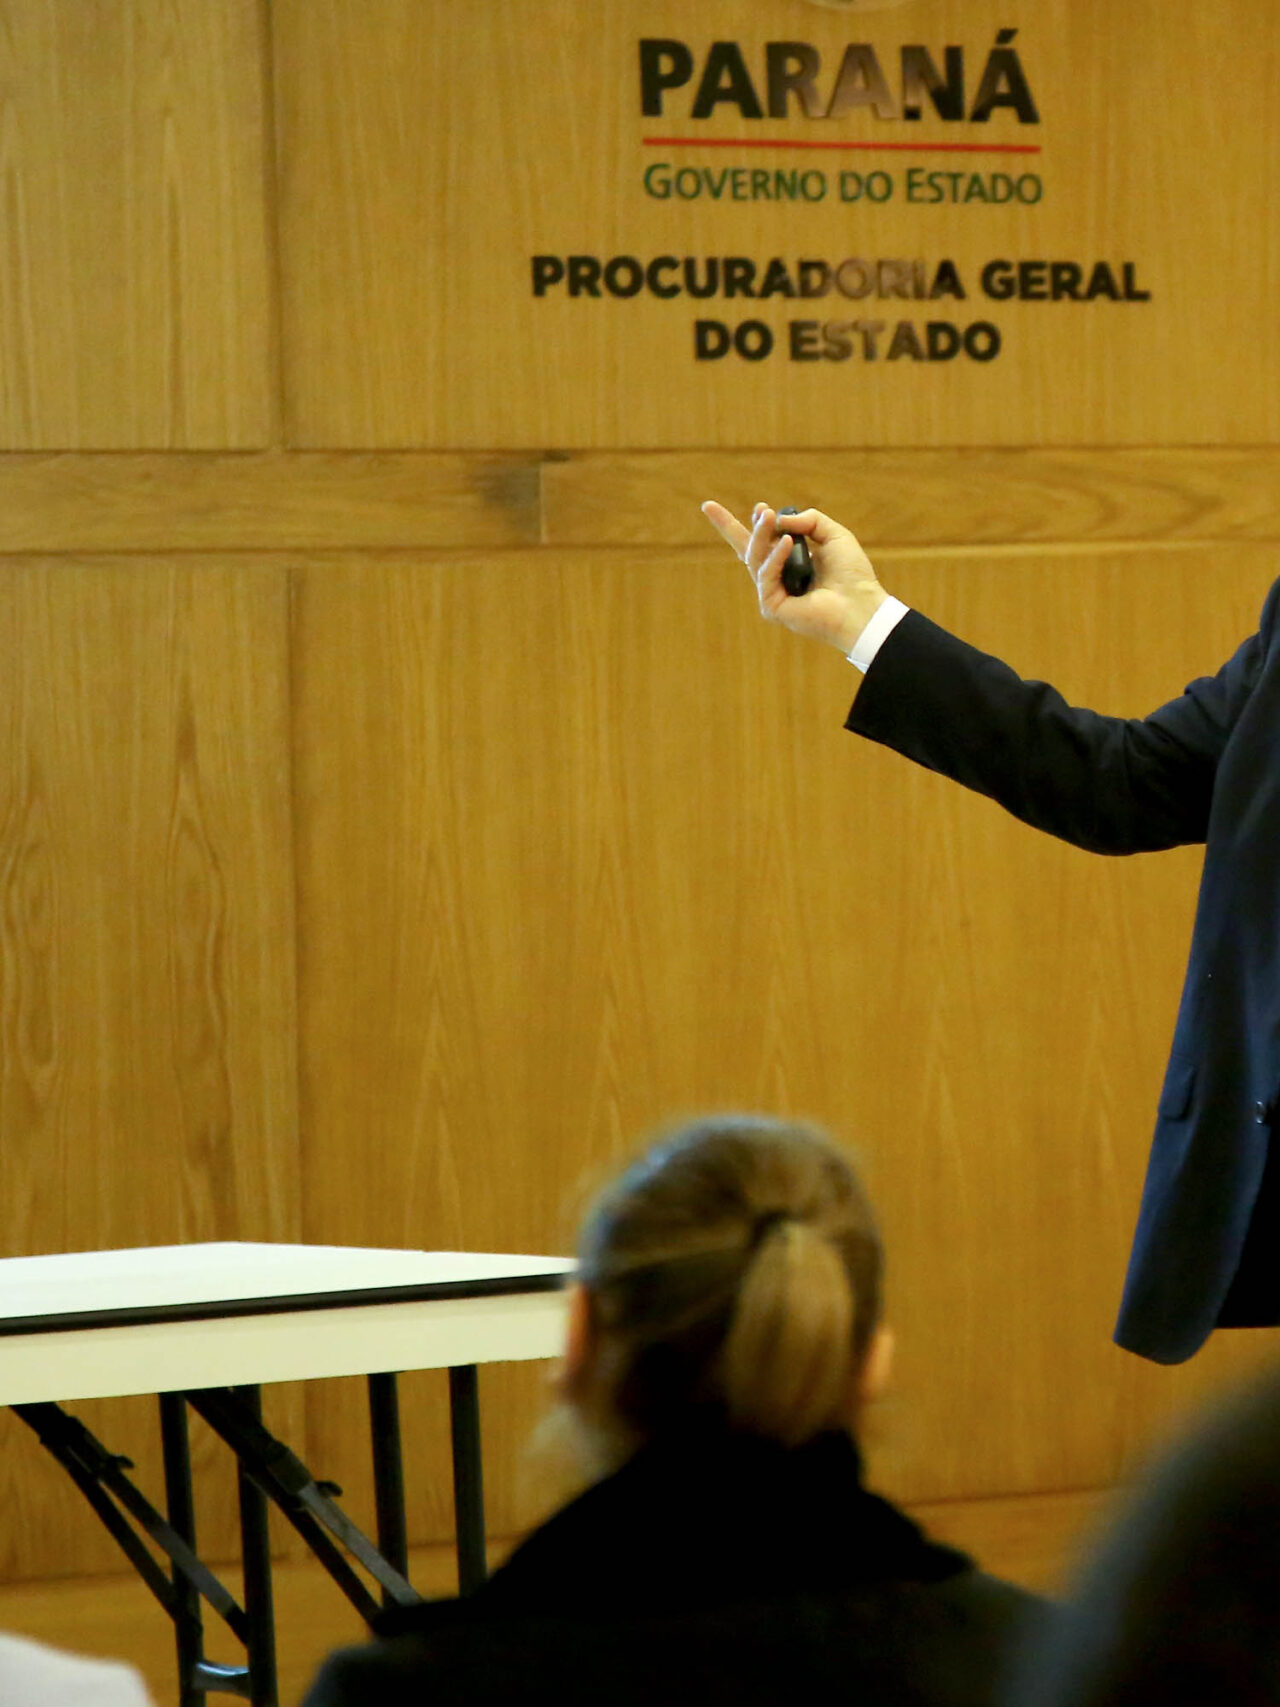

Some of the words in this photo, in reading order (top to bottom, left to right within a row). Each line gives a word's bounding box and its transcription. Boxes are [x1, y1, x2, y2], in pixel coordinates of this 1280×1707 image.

[638, 28, 1040, 124] PARANÁ
[643, 163, 826, 202] GOVERNO
[840, 170, 893, 203] DO
[906, 168, 1043, 205] ESTADO
[531, 255, 966, 300] PROCURADORIA
[982, 260, 1151, 301] GERAL
[694, 320, 772, 361] DO
[789, 320, 1001, 362] ESTADO
